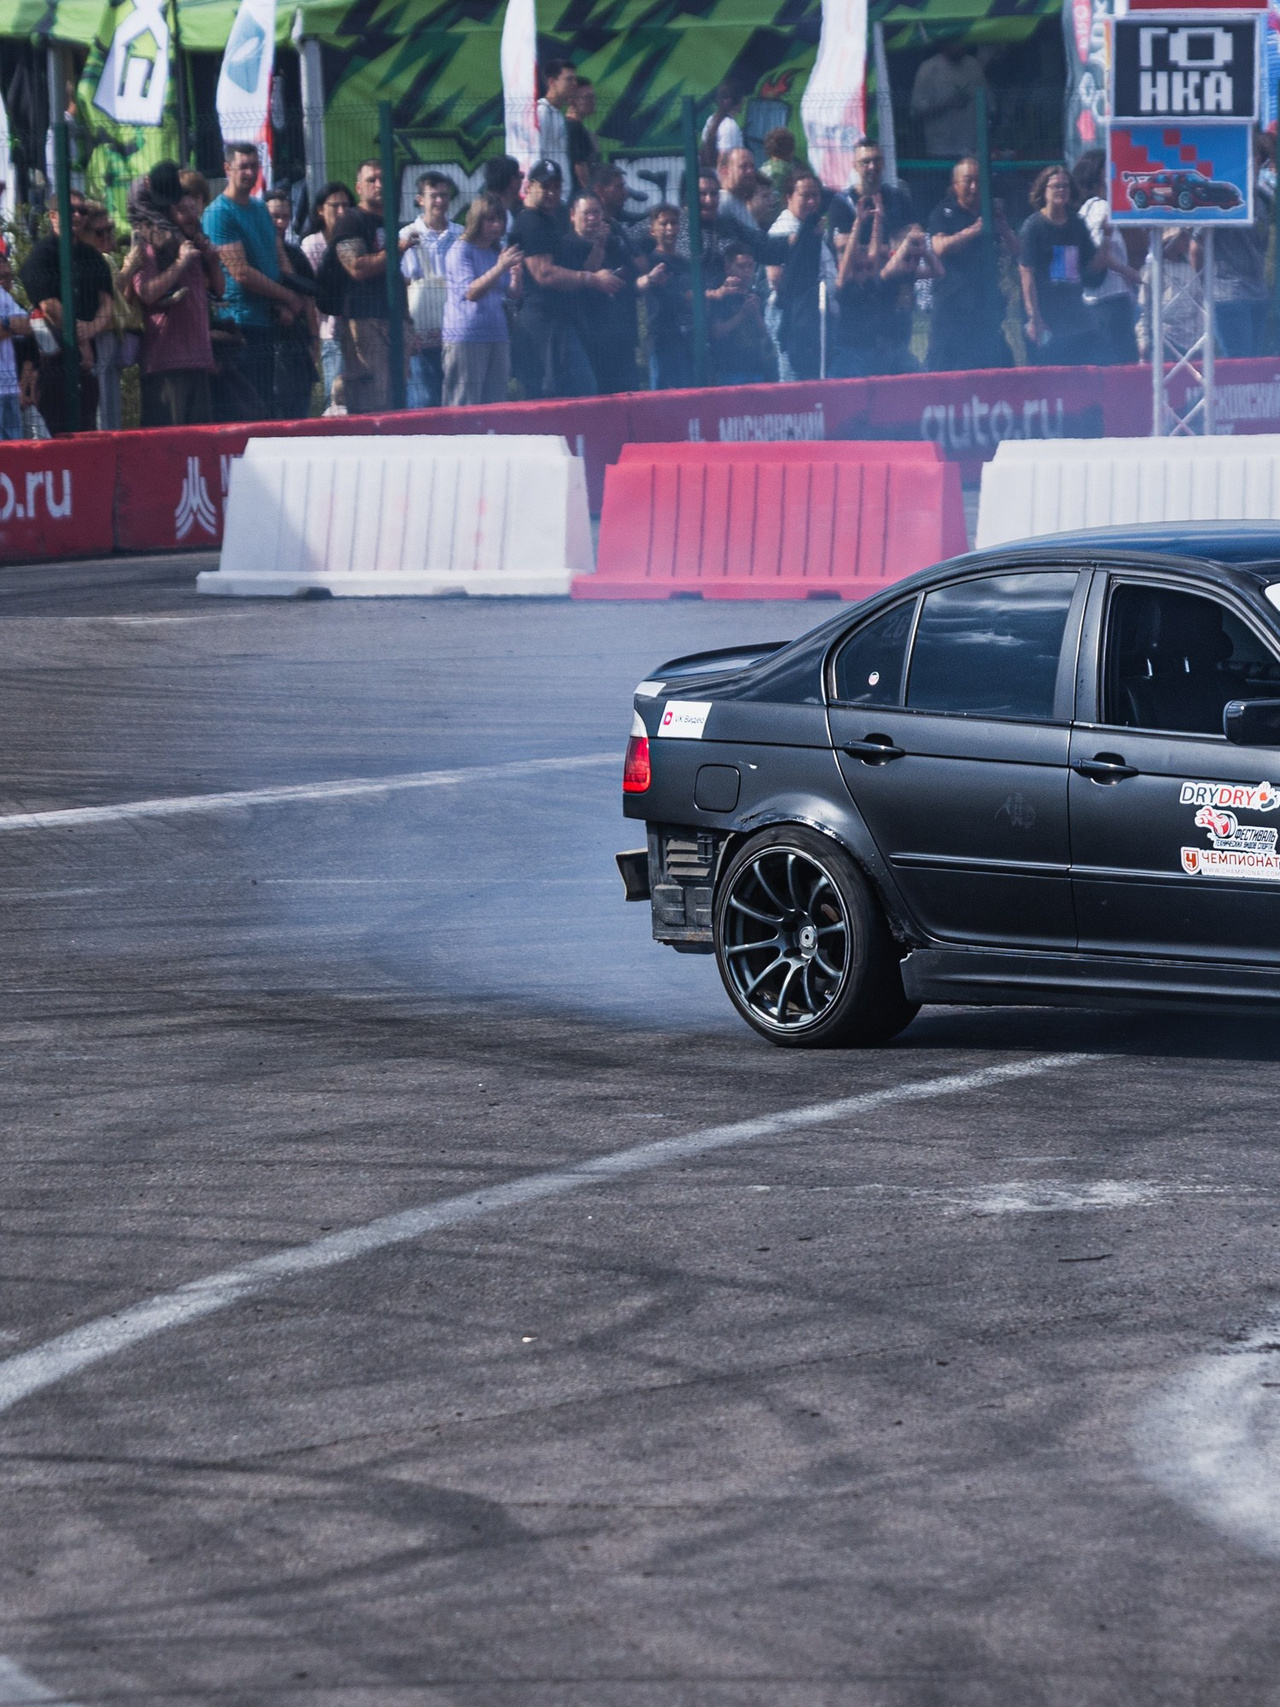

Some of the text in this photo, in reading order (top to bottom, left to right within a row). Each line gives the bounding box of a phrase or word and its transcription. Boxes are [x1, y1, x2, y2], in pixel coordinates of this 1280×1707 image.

[1139, 26, 1234, 67] ГО
[1139, 71, 1234, 111] НКА
[921, 394, 1063, 448] auto.ru
[1182, 785, 1257, 806] DRYDRY
[1201, 852, 1280, 868] ЧЕМПИОНАТ
